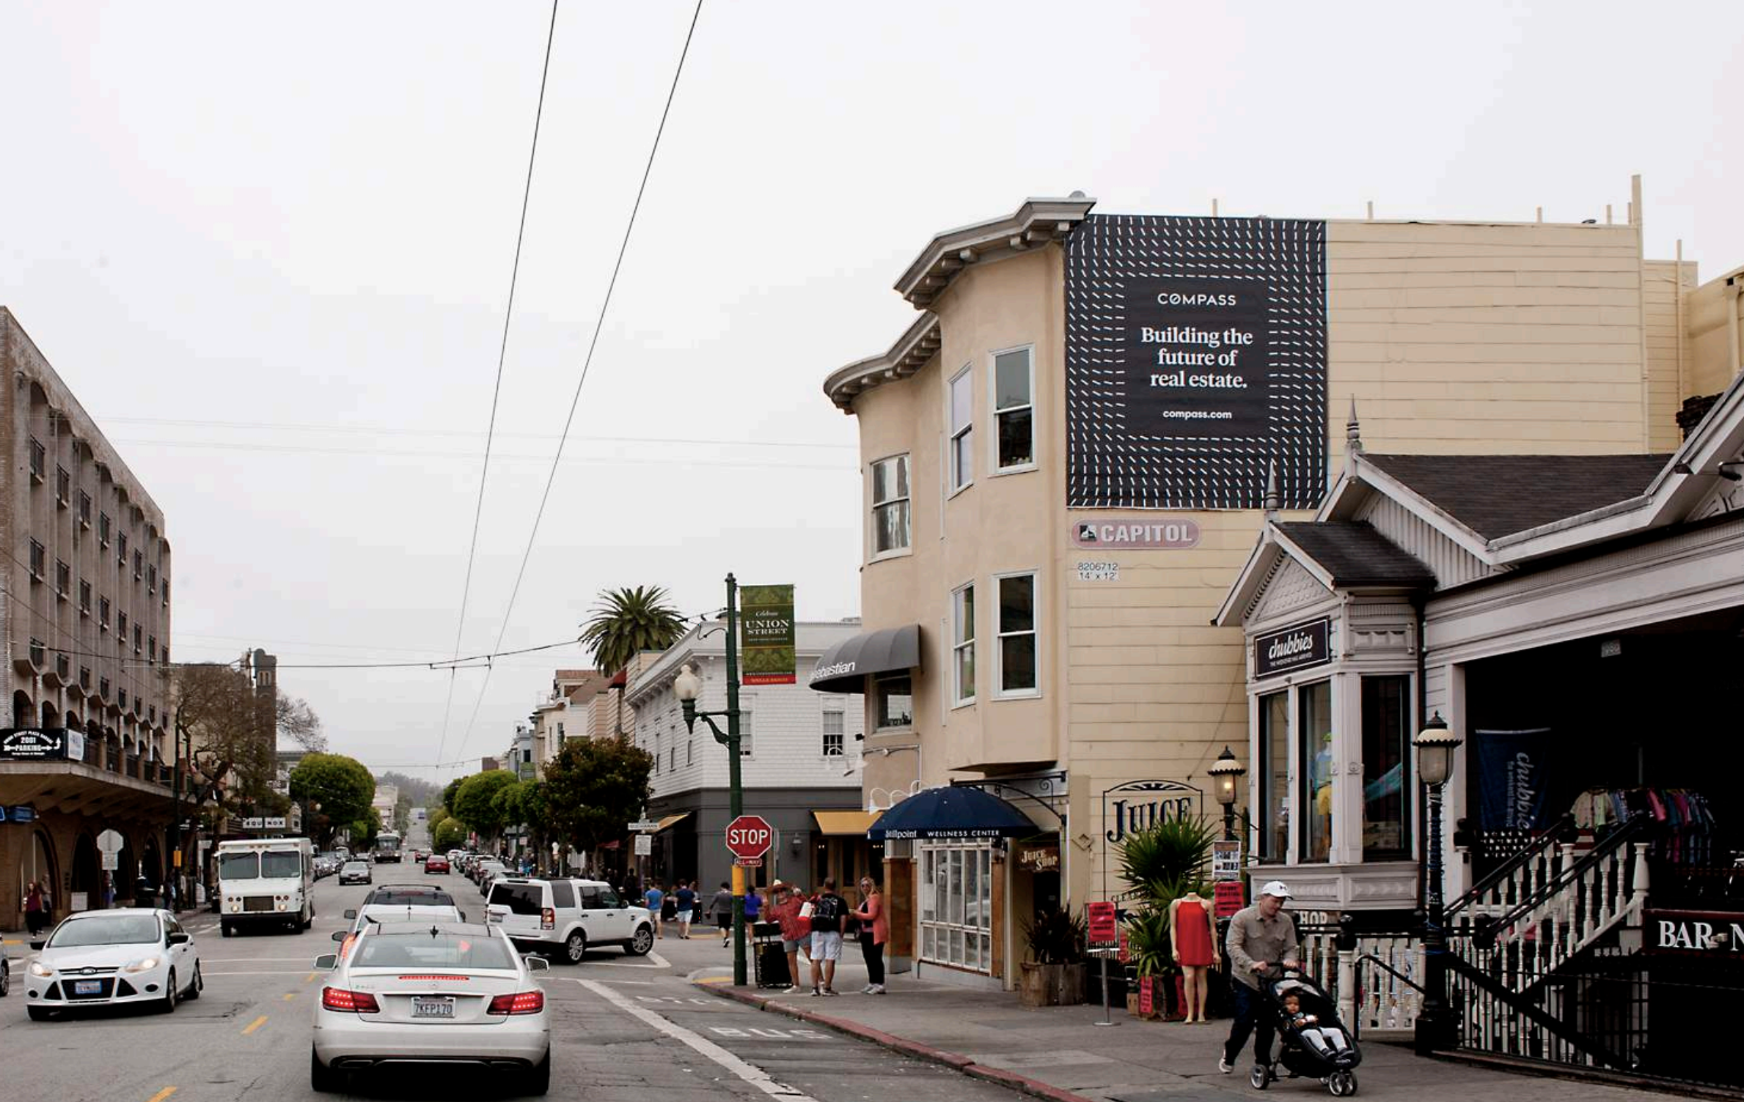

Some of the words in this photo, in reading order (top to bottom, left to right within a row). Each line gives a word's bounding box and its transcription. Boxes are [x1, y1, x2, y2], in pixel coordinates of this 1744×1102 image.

[1157, 293, 1236, 306] COMPASS
[1141, 327, 1220, 348] Building
[1223, 328, 1253, 345] the
[1158, 348, 1215, 366] future
[1218, 350, 1238, 366] of
[1150, 371, 1186, 387] real
[1188, 373, 1248, 388] estate.
[1163, 411, 1232, 420] compass.com
[1101, 525, 1193, 542] CAPITOL
[1077, 562, 1119, 571] 8206712
[745, 620, 789, 628] UNION
[1269, 632, 1312, 659] chubbies
[1516, 752, 1535, 830] chubbie
[1107, 796, 1191, 843] JUICE
[730, 829, 768, 844] STOP
[971, 829, 1000, 837] CENTER
[1294, 910, 1328, 925] HOP
[1657, 920, 1714, 950] BAR
[709, 1026, 833, 1040] BUS
